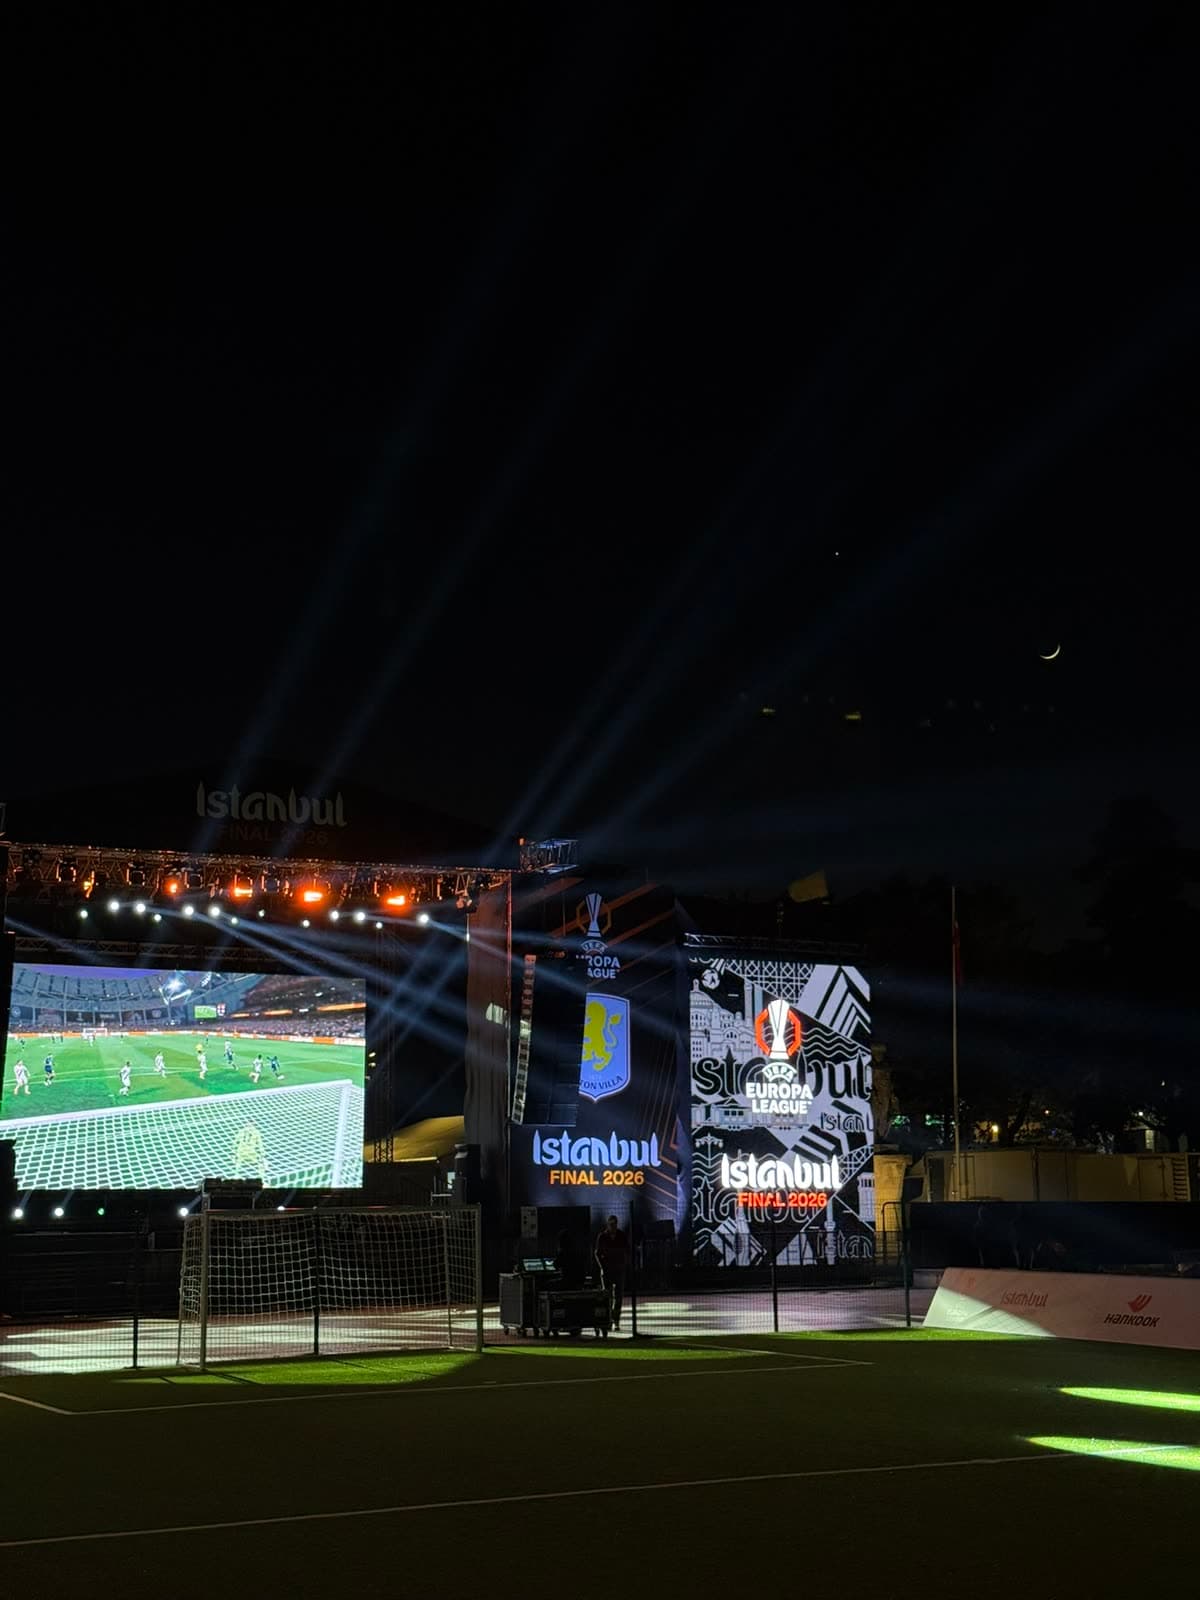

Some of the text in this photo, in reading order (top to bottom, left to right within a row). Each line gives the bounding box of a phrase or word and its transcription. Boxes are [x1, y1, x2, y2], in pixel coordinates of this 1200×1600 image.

[196, 779, 348, 827] Istanbul
[582, 941, 606, 953] UEFA
[576, 955, 621, 968] ROPA
[586, 967, 617, 979] AGUE
[765, 1064, 794, 1082] UEFA
[598, 1075, 623, 1090] VILLA
[745, 1082, 814, 1100] EUROPA
[752, 1100, 809, 1115] LEAGUE
[533, 1129, 662, 1167] Istanbul
[550, 1170, 645, 1186] FINAL 2026
[721, 1153, 844, 1190] Istanbul
[738, 1192, 828, 1208] FINAL 2026
